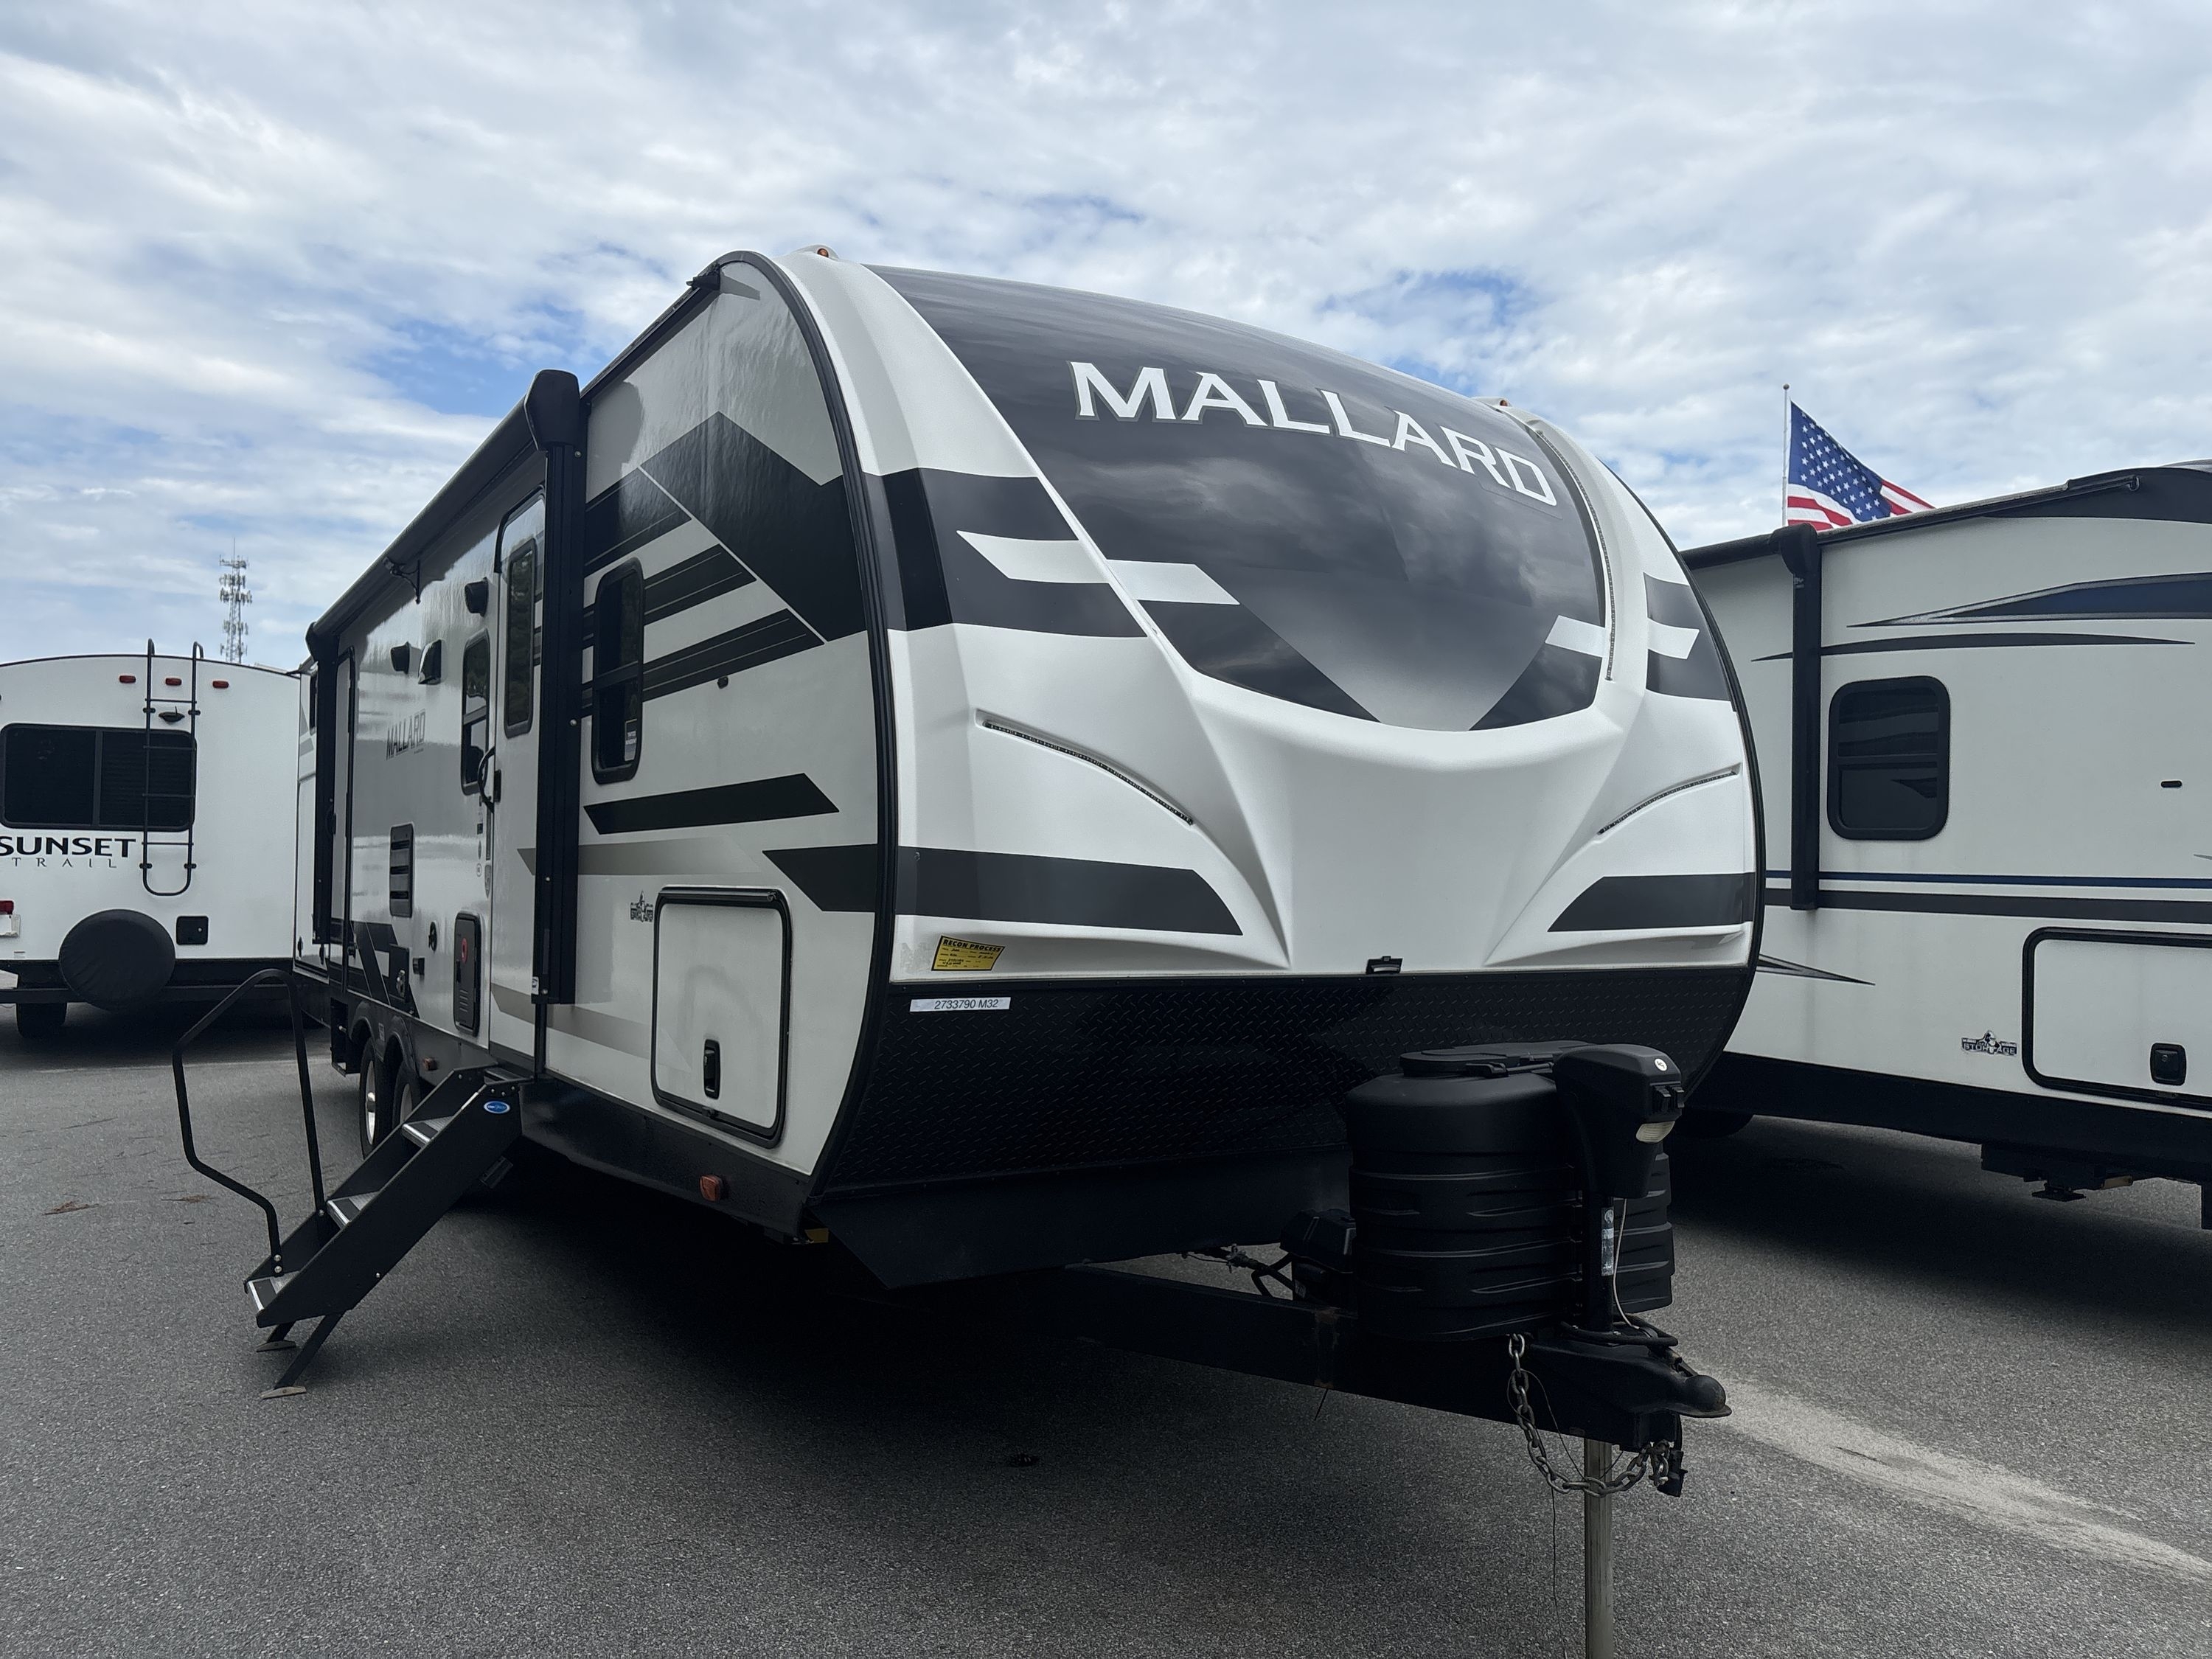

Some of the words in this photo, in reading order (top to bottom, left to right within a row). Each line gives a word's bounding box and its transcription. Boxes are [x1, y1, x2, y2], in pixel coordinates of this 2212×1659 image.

[1068, 361, 1558, 507] MALLARD
[386, 710, 426, 761] MALLARD
[0, 835, 136, 858] SUNSET
[12, 857, 117, 868] TRAIL
[942, 939, 968, 948] RECON
[969, 944, 1001, 953] PROCESS
[934, 1000, 976, 1009] 2733790
[978, 999, 998, 1008] M32
